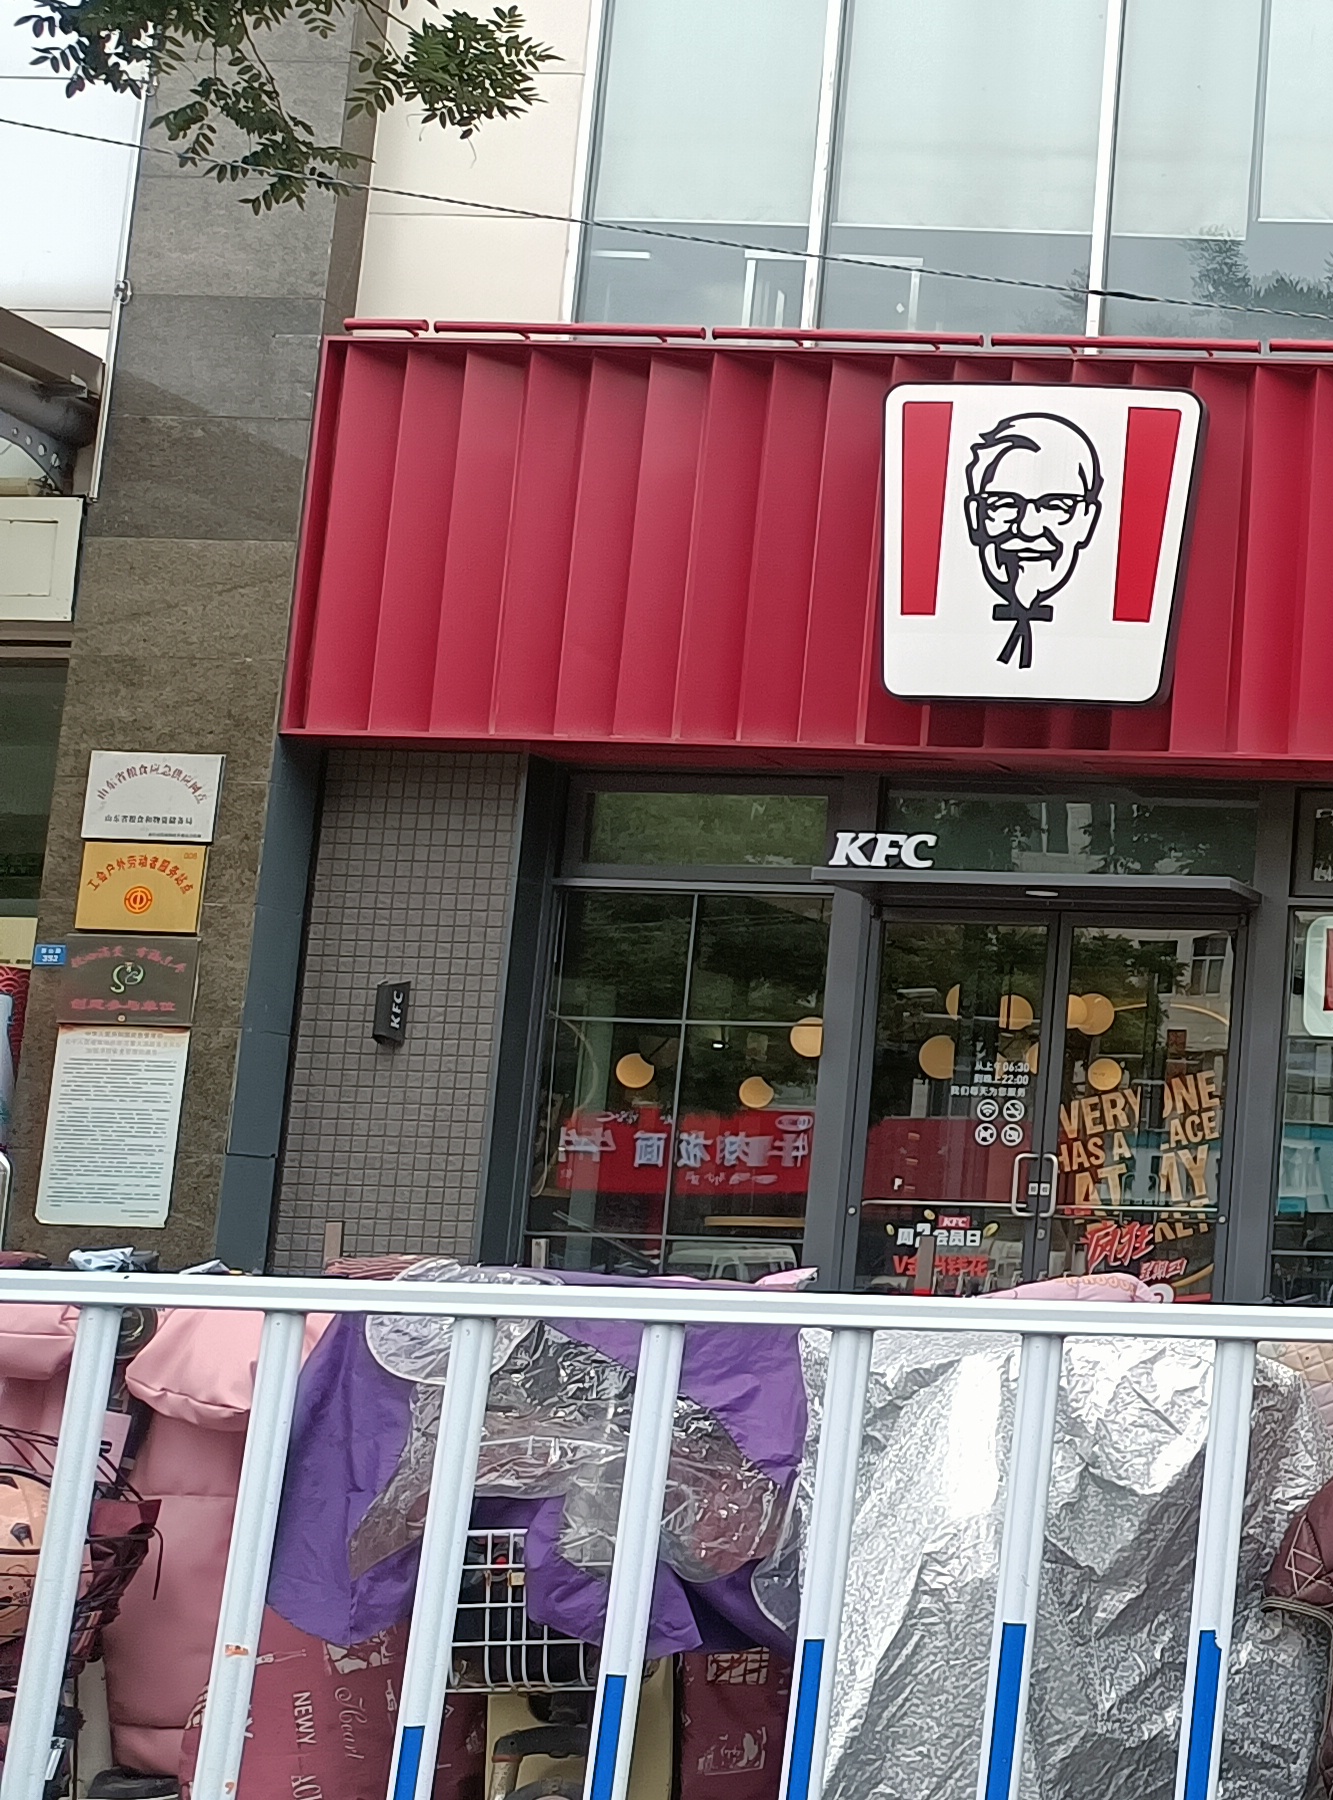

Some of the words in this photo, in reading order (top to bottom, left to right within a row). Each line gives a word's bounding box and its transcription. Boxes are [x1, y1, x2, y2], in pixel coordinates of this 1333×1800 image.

[828, 832, 937, 868] KFC
[87, 854, 194, 894] 工会户外劳动者服务站点
[390, 990, 404, 1029] KFC
[942, 1217, 968, 1228] KFC
[1079, 1219, 1154, 1275] 疯狂
